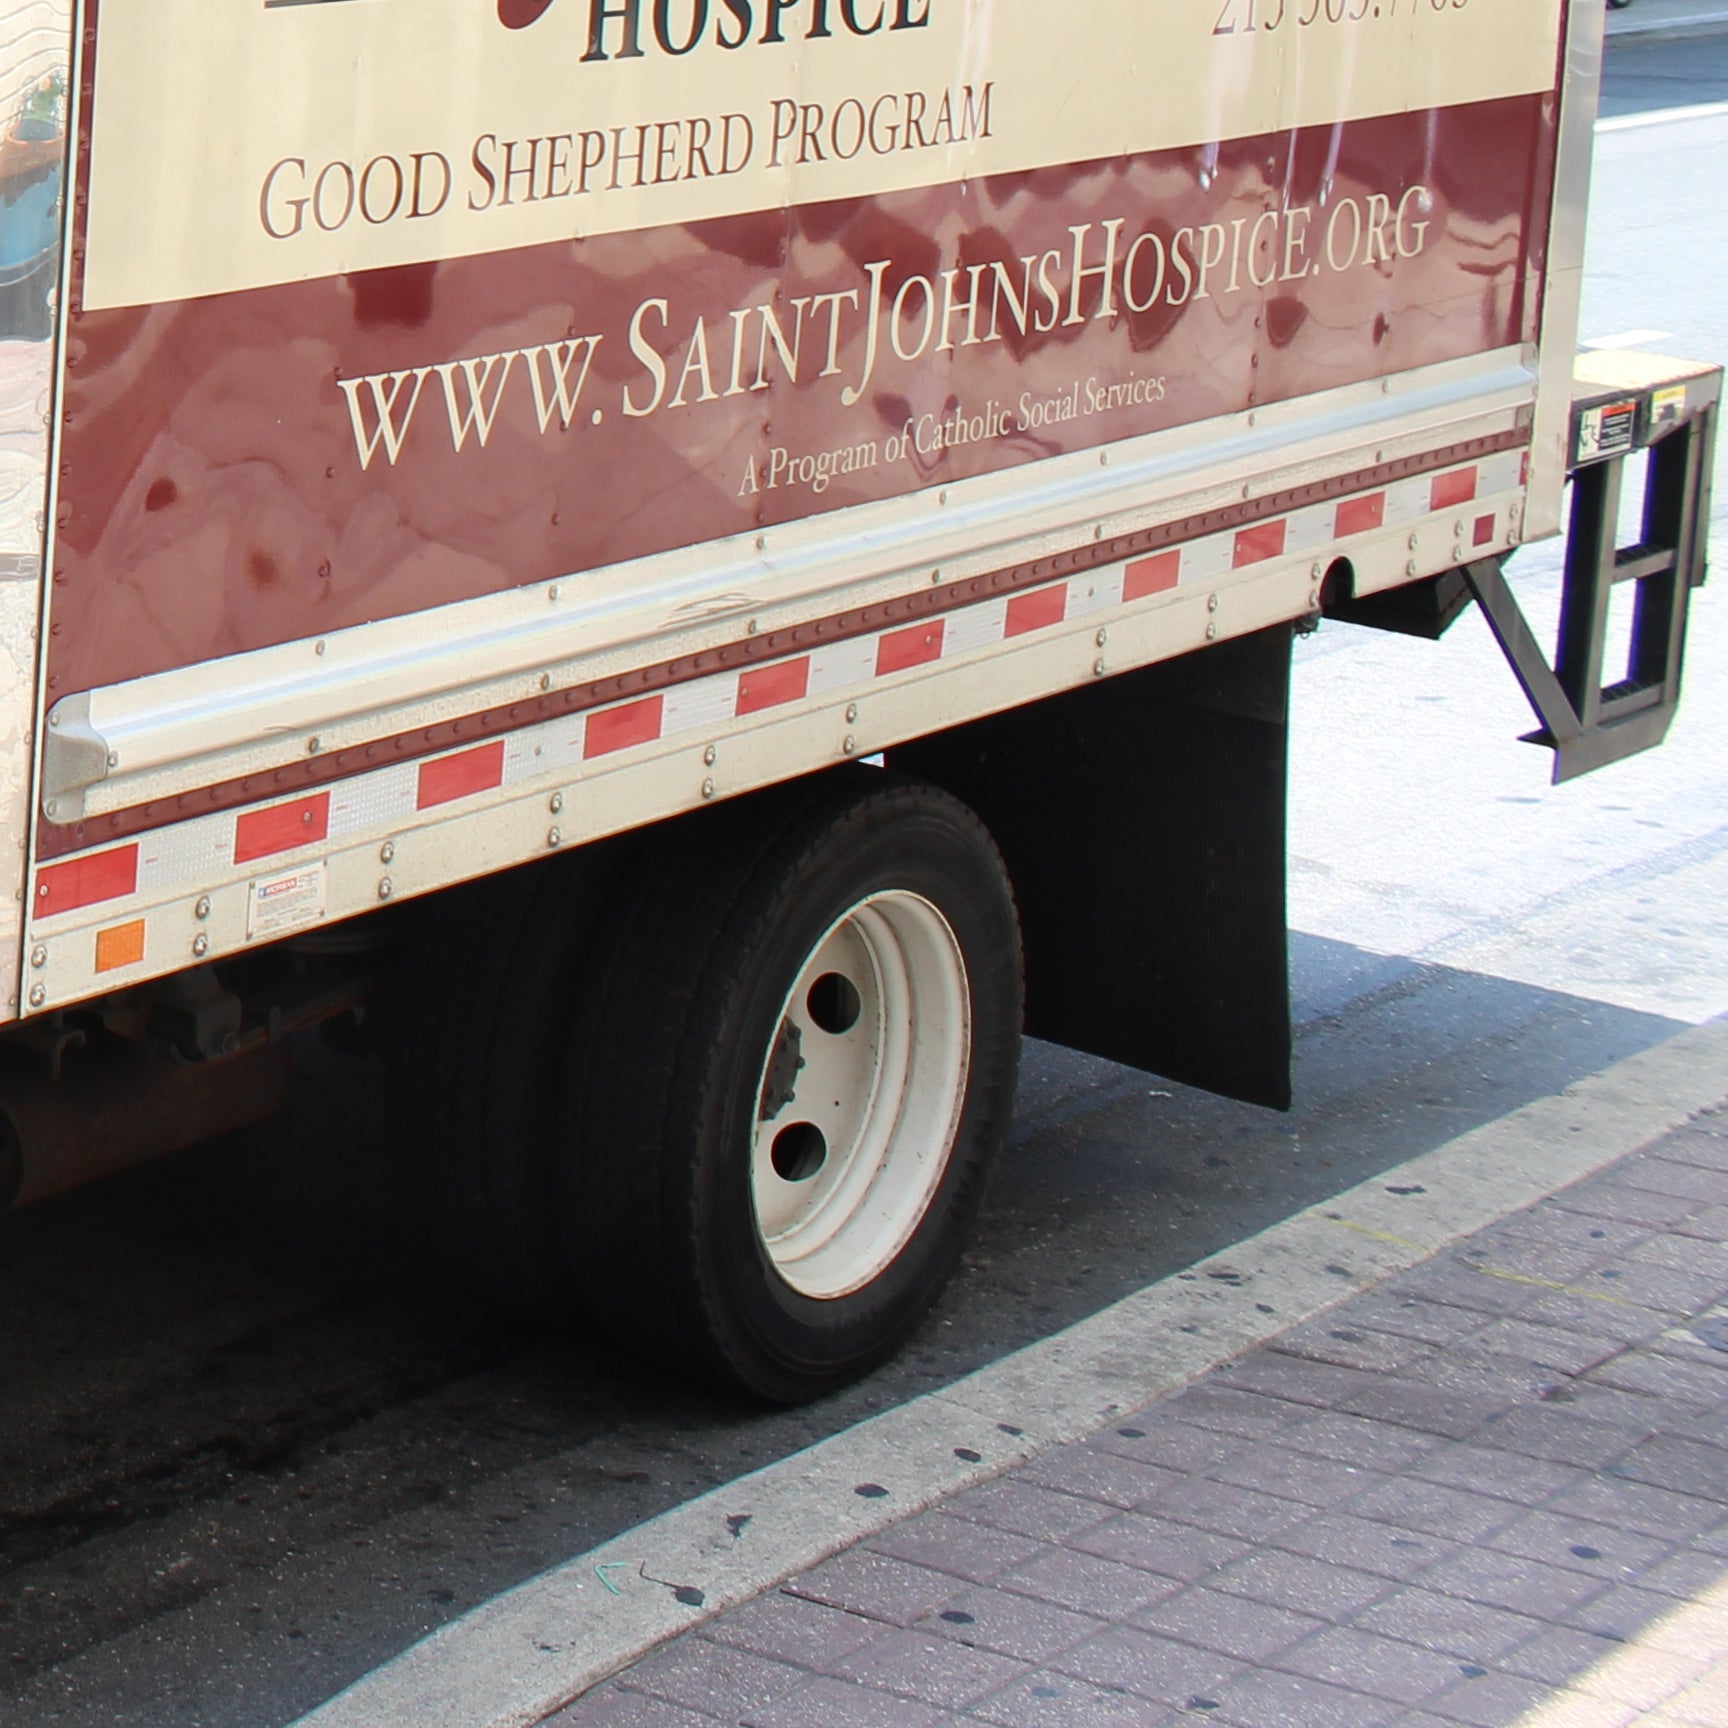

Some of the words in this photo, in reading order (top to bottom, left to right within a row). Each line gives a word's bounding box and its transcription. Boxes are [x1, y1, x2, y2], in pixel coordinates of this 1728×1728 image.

[258, 149, 452, 239] GOOD
[467, 111, 754, 212] SHEPHERD
[765, 80, 995, 170] PROGRAM
[737, 454, 760, 497] A
[768, 440, 878, 494] Program
[884, 418, 913, 461] of
[915, 399, 1012, 452] Catholic
[1017, 380, 1079, 432] Social
[1083, 370, 1167, 416] Services
